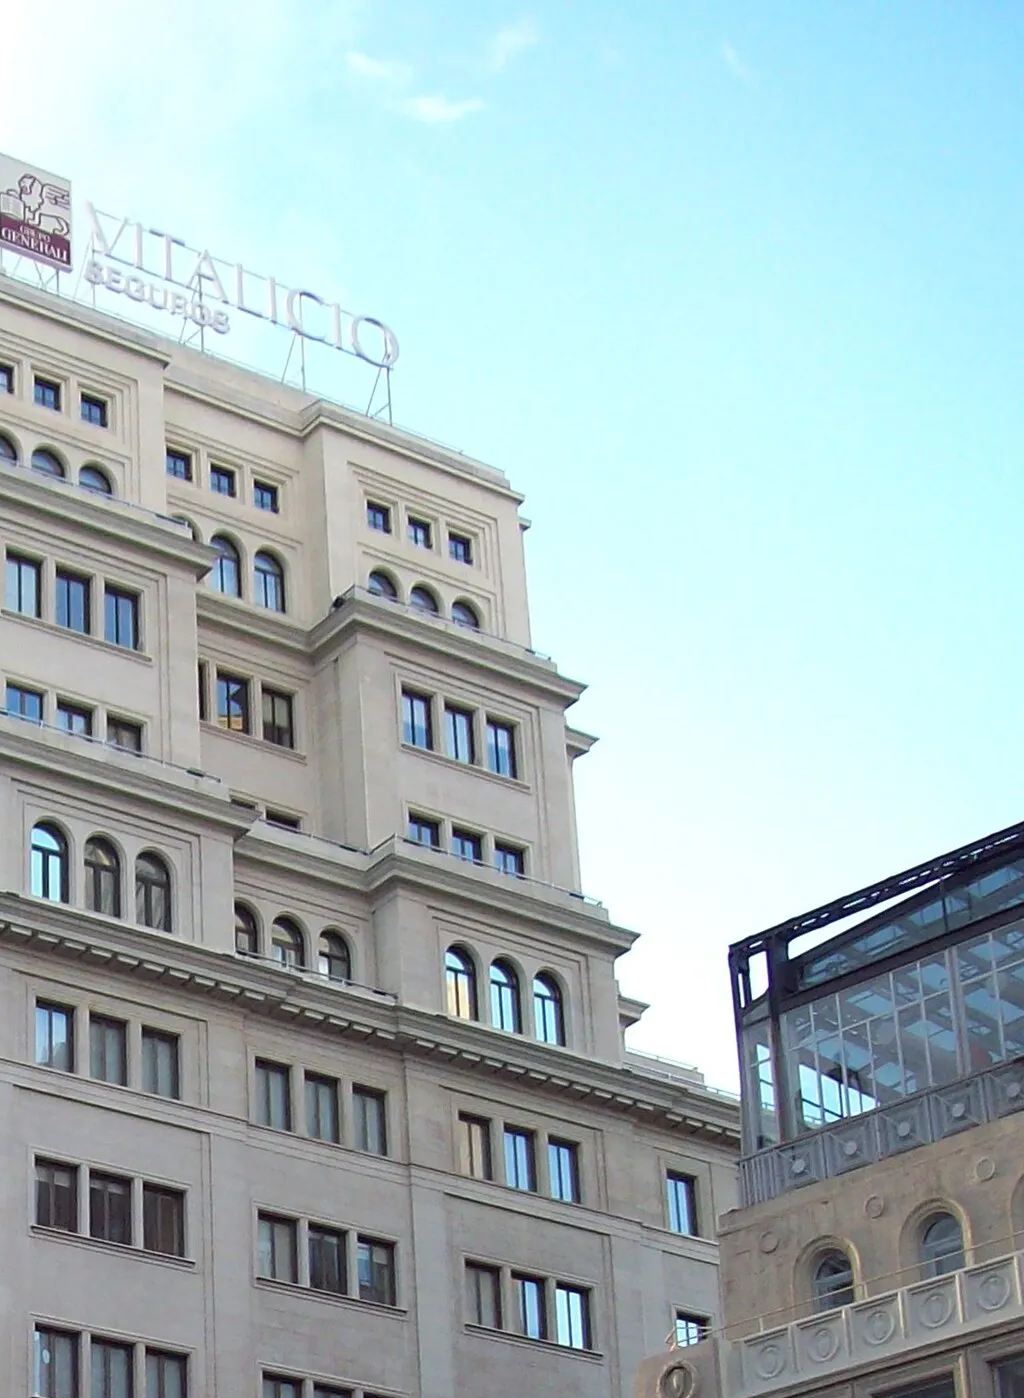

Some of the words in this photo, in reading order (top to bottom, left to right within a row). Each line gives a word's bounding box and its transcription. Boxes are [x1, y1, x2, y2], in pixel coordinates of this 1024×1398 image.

[1, 227, 68, 262] GENERALI
[84, 259, 231, 335] SEGUROS
[86, 200, 400, 368] VITALICIO
